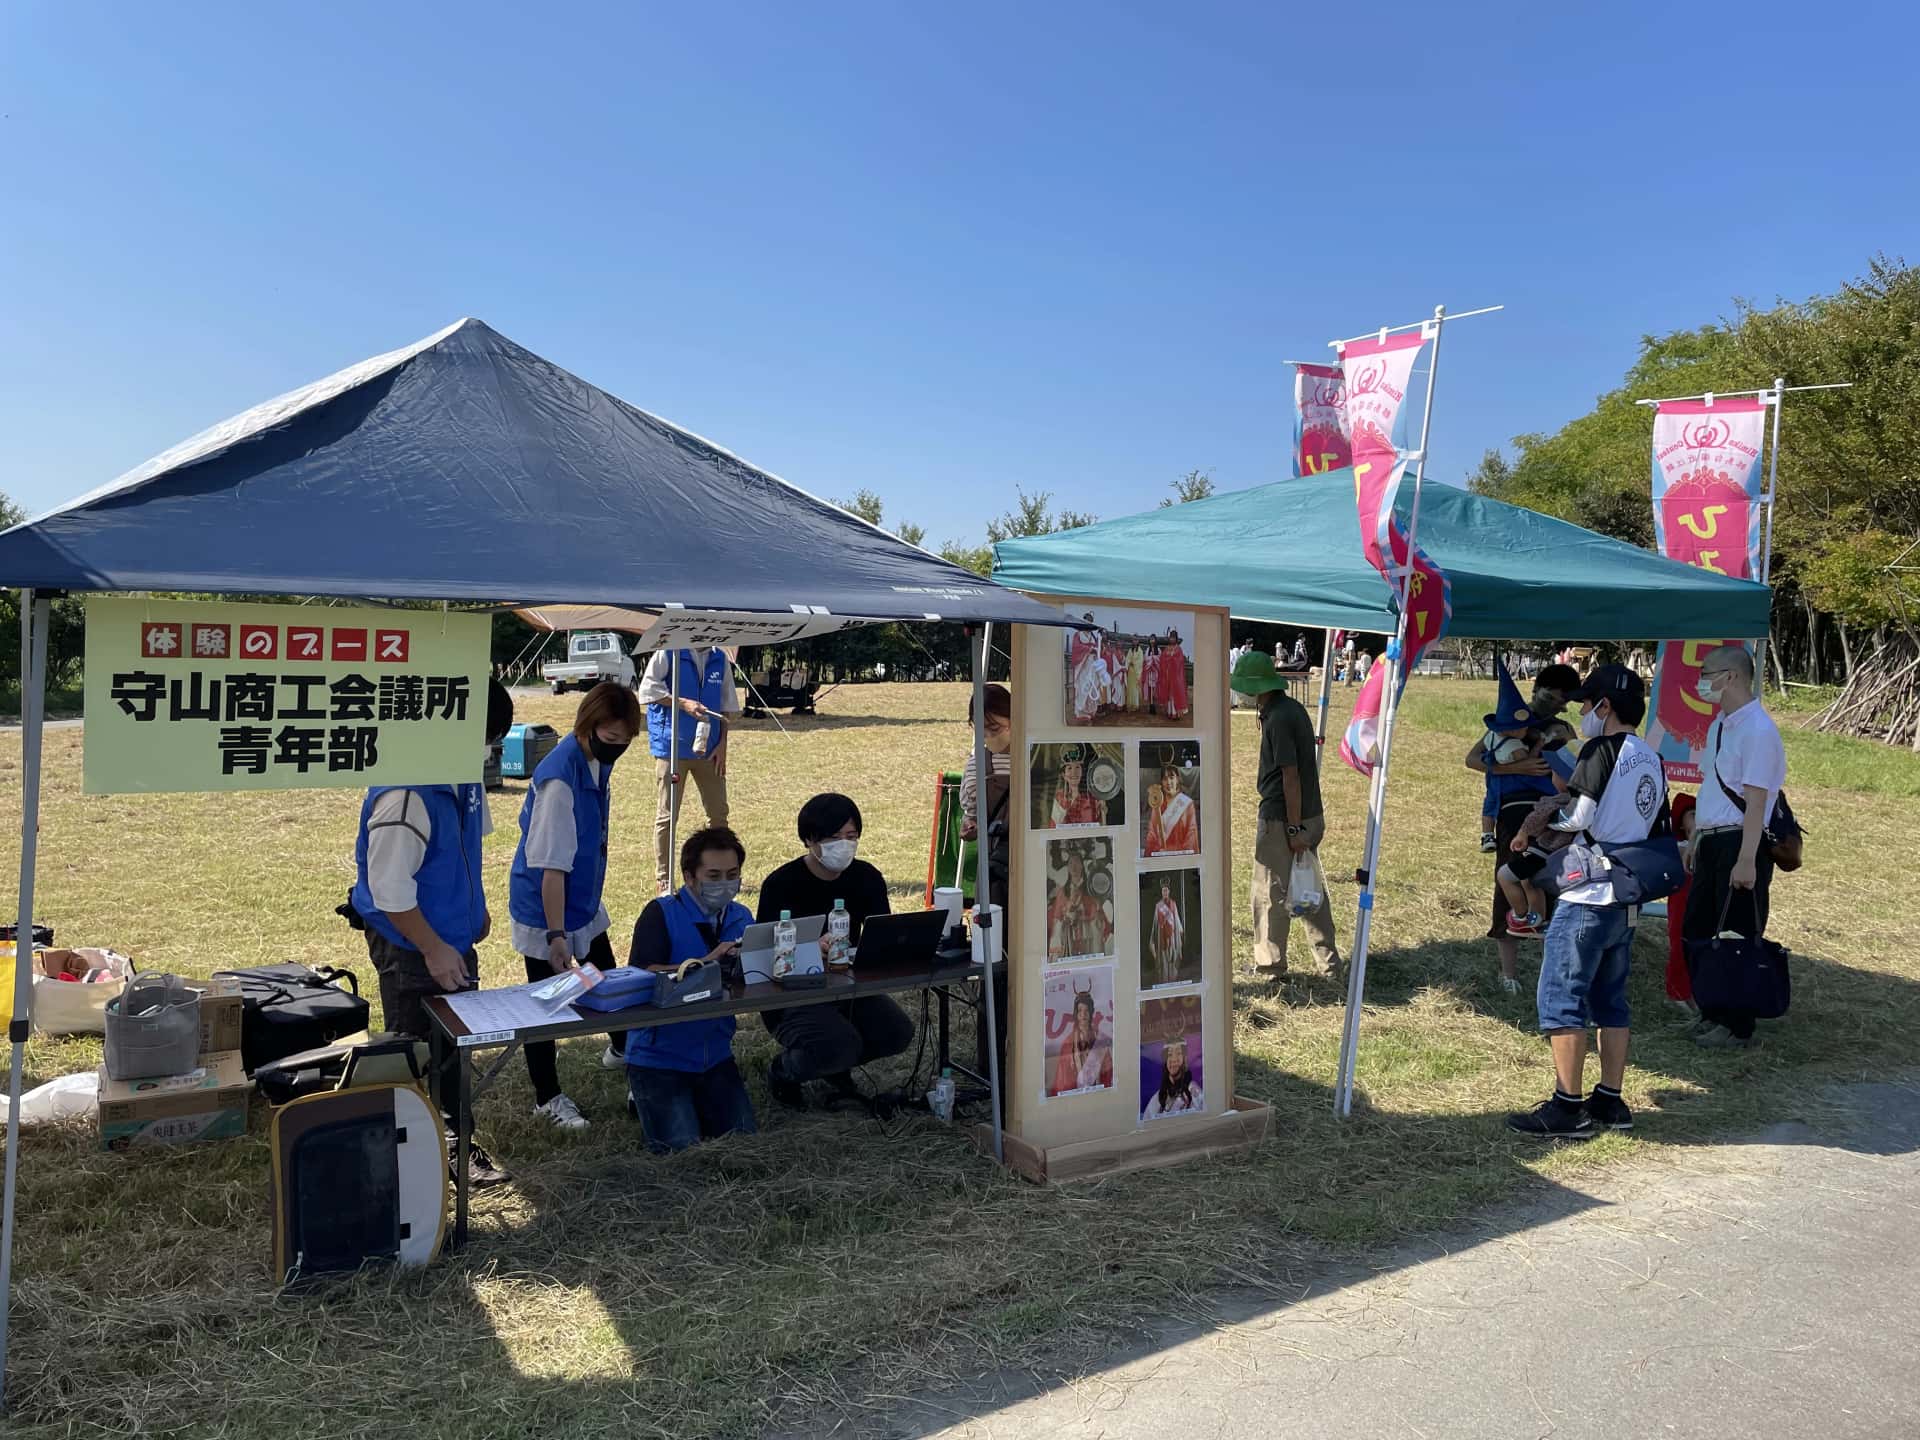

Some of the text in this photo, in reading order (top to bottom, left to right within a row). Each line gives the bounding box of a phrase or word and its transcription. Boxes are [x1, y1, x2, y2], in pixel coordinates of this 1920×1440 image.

[143, 624, 407, 661] 体験のブース
[110, 671, 470, 722] 守山商工会議所
[217, 726, 378, 775] 青年部
